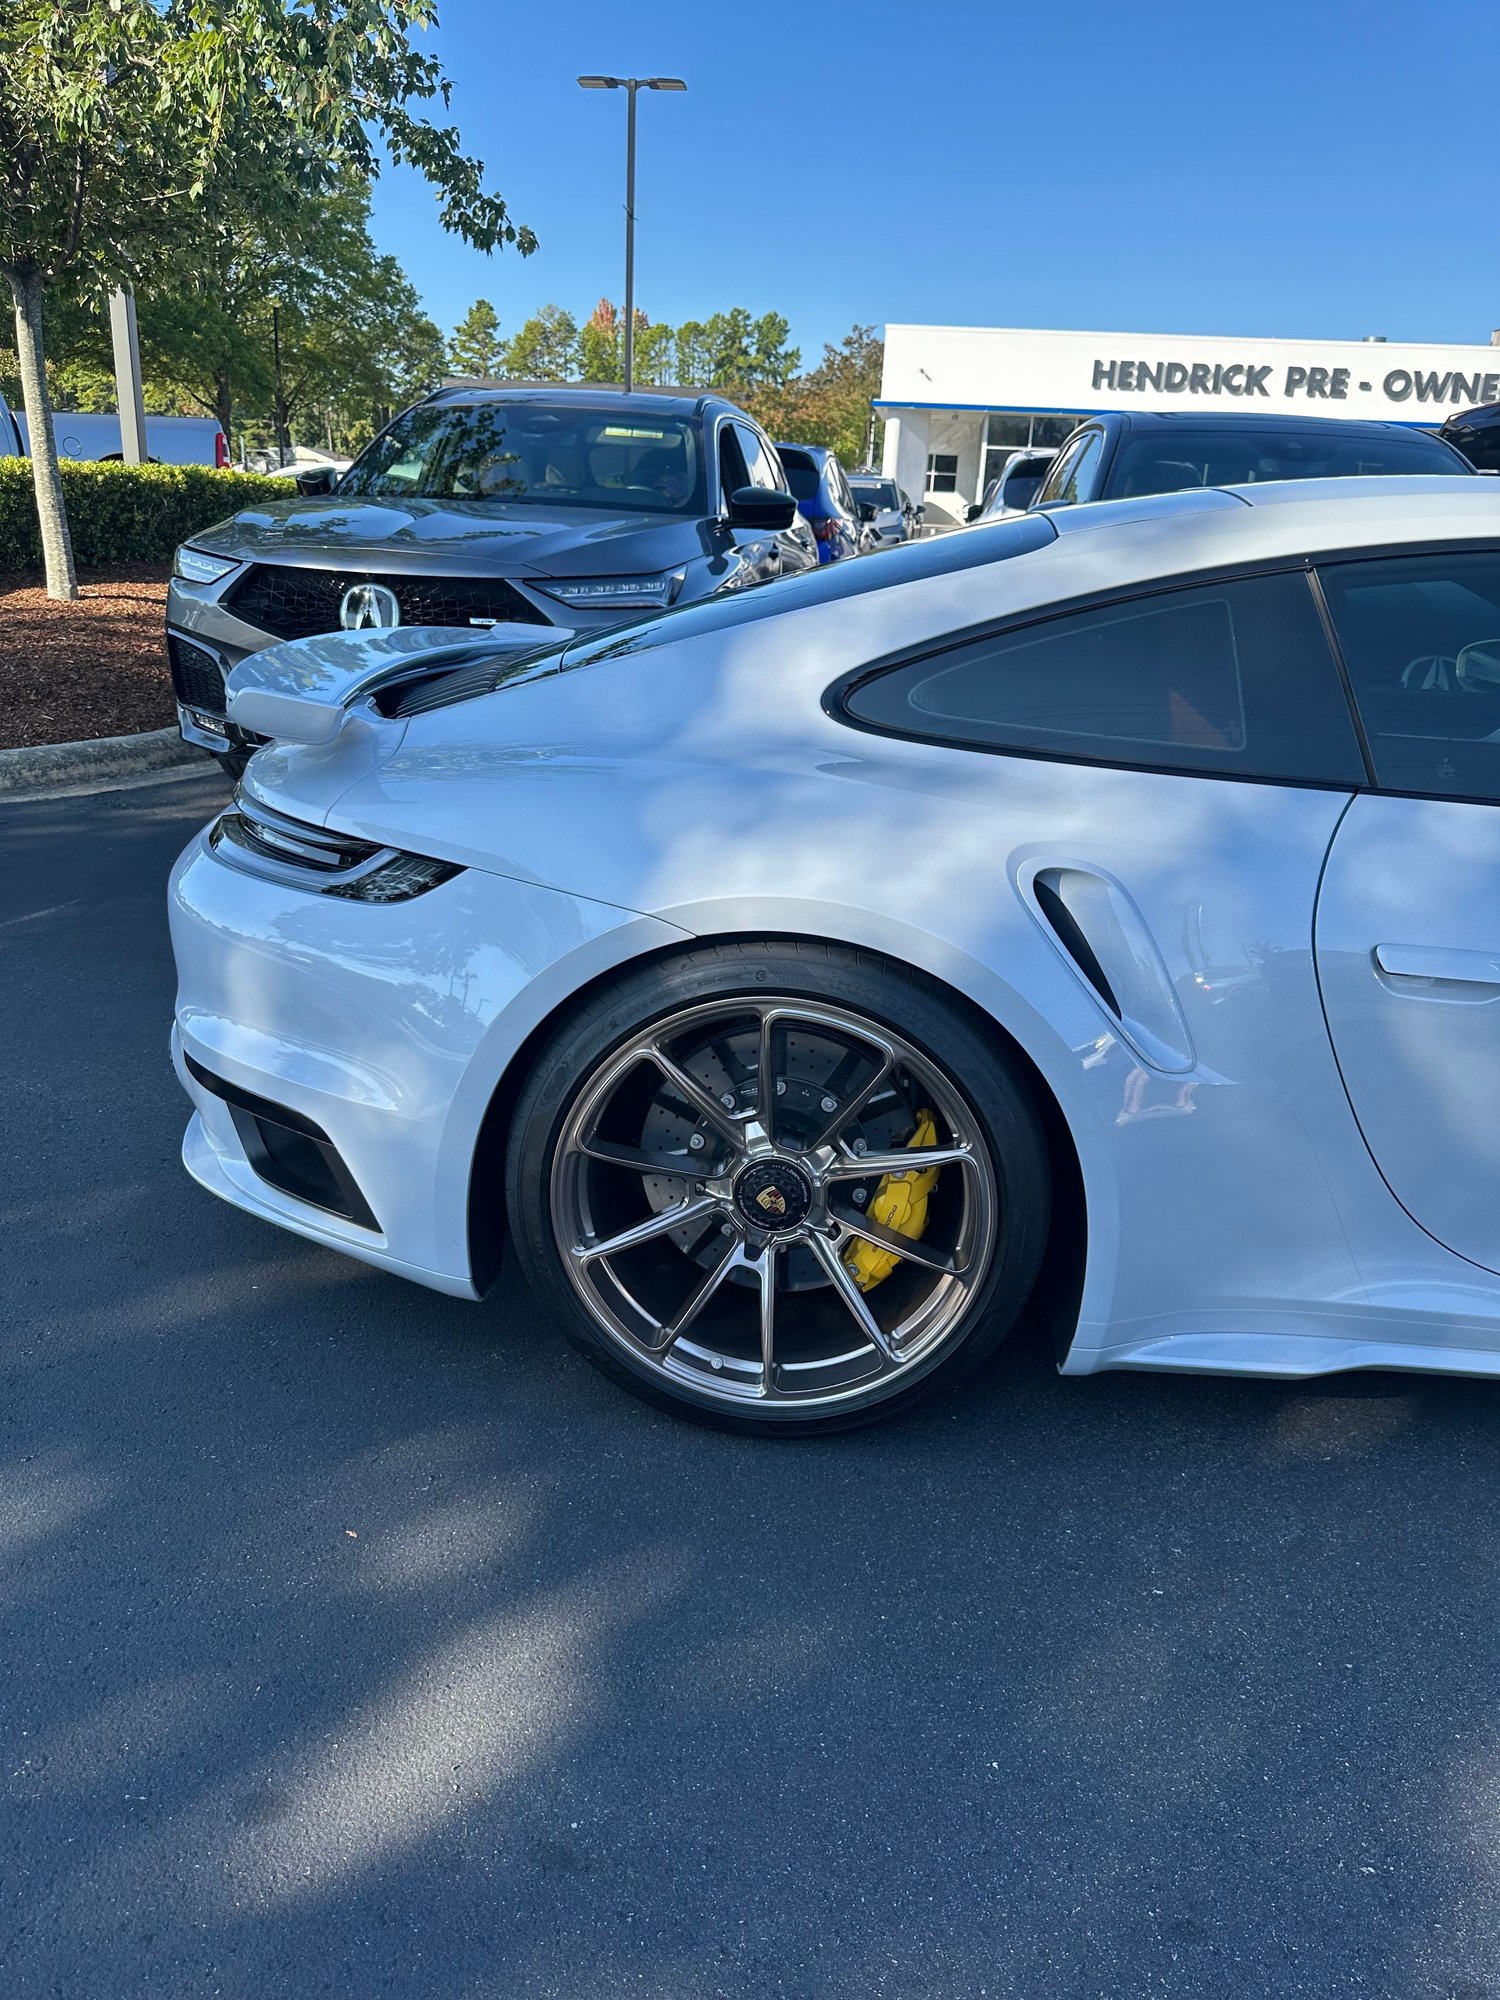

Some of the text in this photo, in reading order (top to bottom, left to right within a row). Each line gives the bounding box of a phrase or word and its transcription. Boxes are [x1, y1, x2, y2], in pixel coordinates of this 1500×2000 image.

[1092, 360, 1273, 397] HENDRICK
[1284, 366, 1350, 399] PRE
[871, 1205, 897, 1254] PORE
